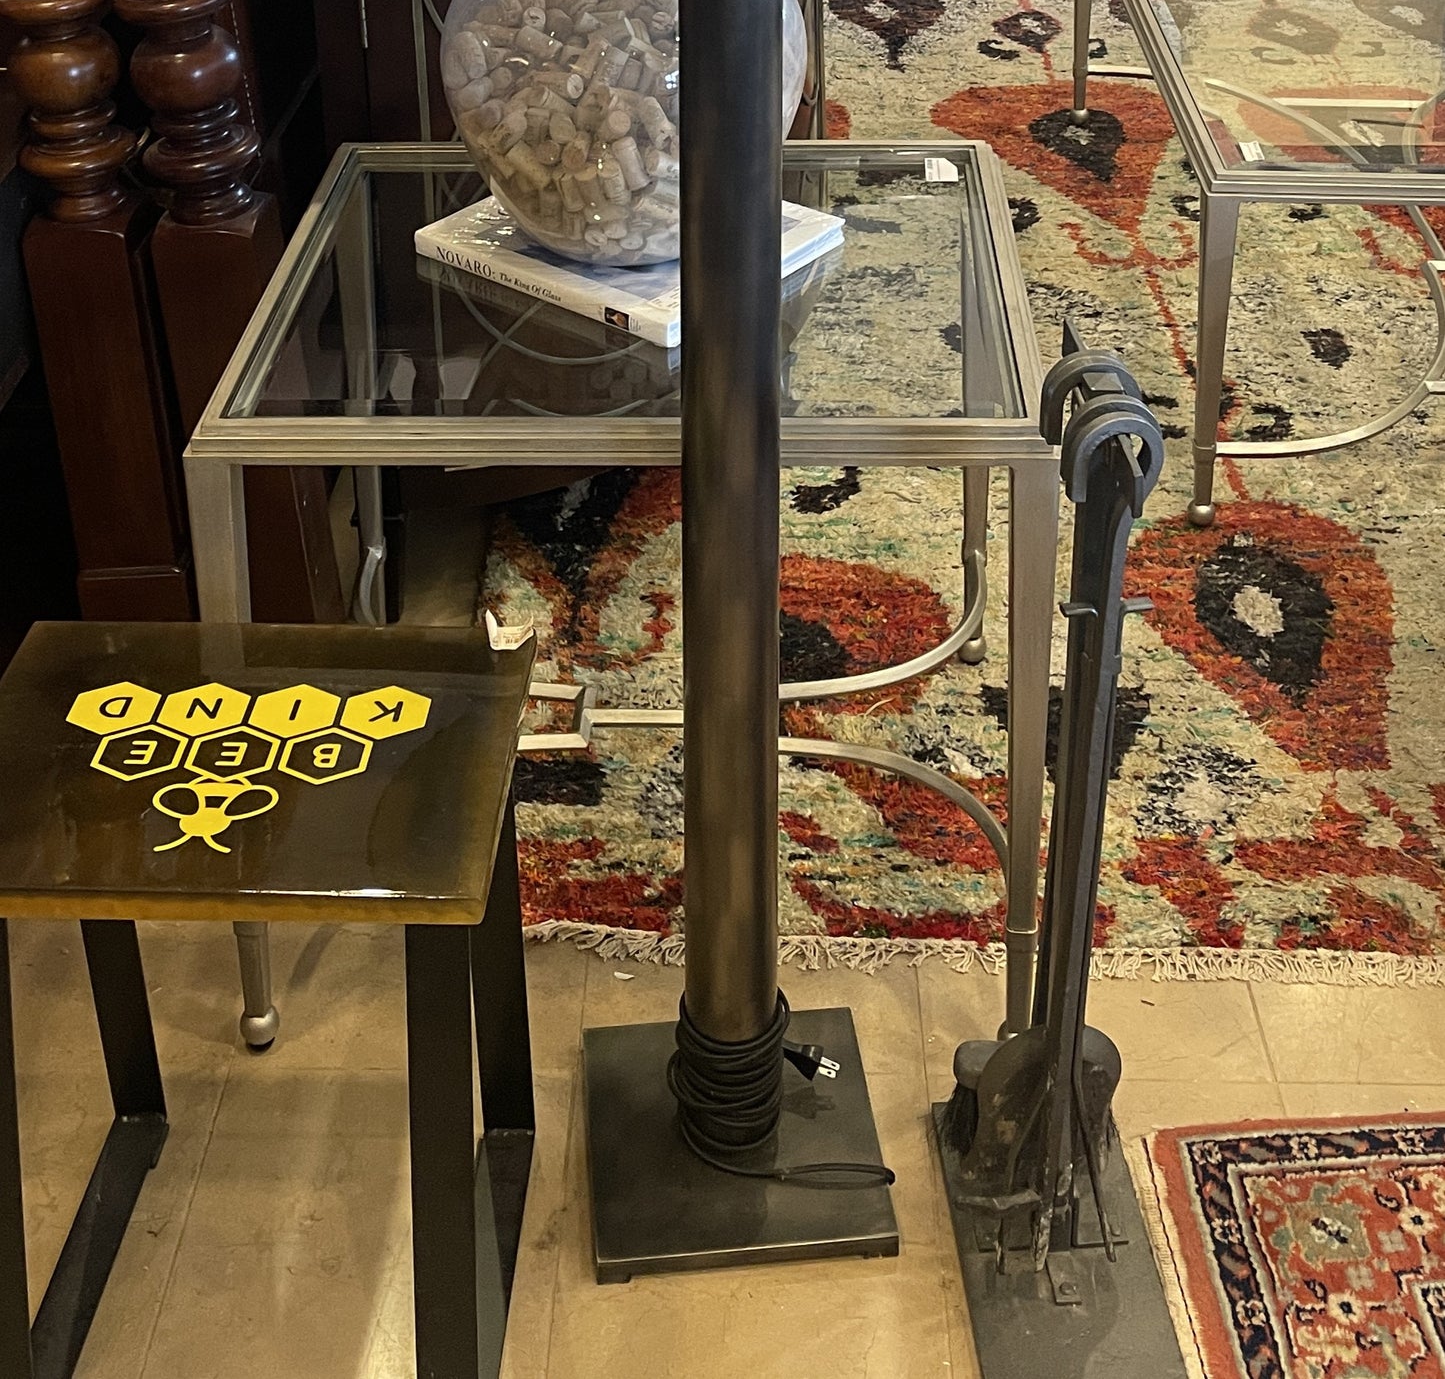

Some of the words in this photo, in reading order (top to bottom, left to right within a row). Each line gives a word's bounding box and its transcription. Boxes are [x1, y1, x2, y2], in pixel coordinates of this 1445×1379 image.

[436, 246, 496, 279] NOVARO:
[499, 272, 512, 283] The
[514, 278, 530, 292] King
[531, 284, 542, 296] Of
[542, 289, 562, 302] Glass
[99, 696, 404, 722] KIND
[123, 740, 342, 769] BEE
